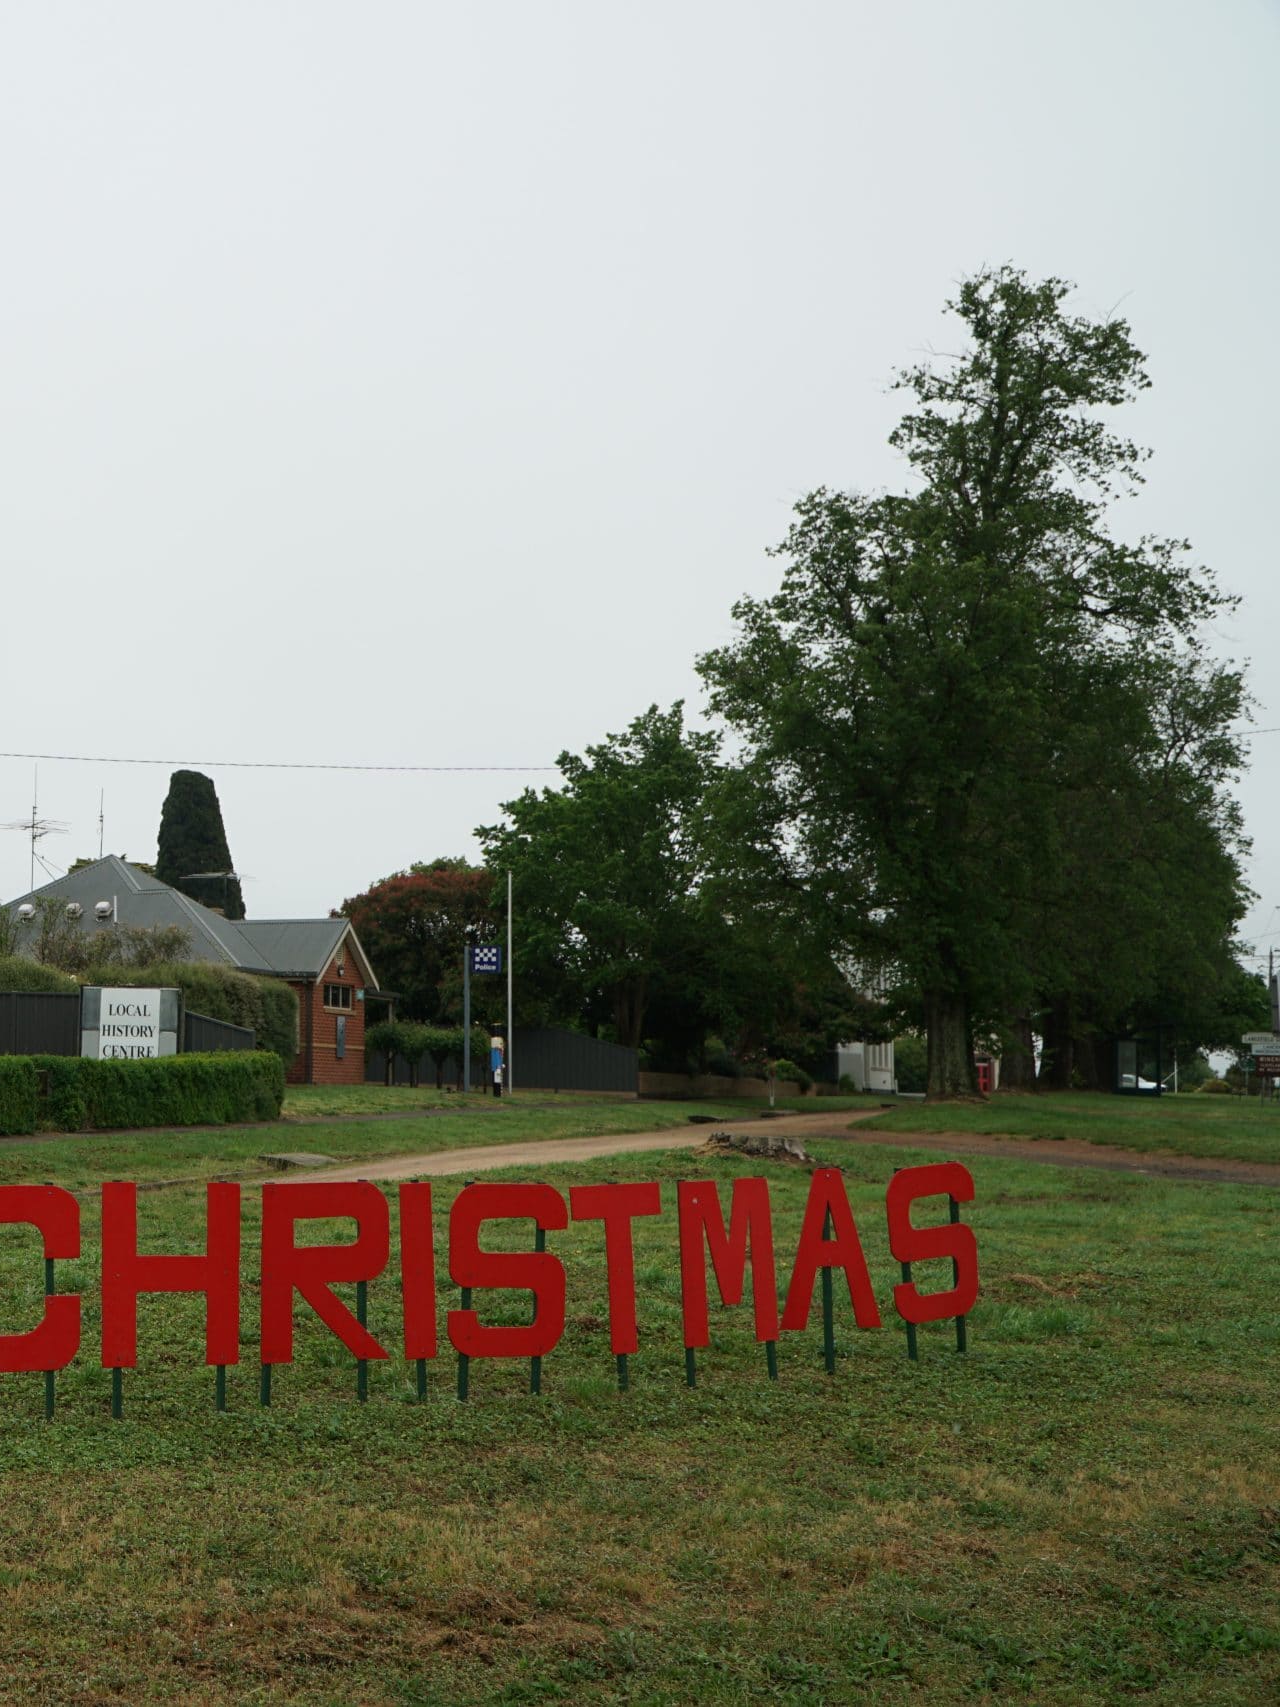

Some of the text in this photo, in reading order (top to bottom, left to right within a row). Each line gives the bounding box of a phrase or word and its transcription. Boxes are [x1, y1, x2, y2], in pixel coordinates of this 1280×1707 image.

[474, 963, 497, 971] Police
[108, 1003, 151, 1017] LOCAL
[101, 1024, 156, 1038] HISTORY
[102, 1044, 154, 1058] CENTRE
